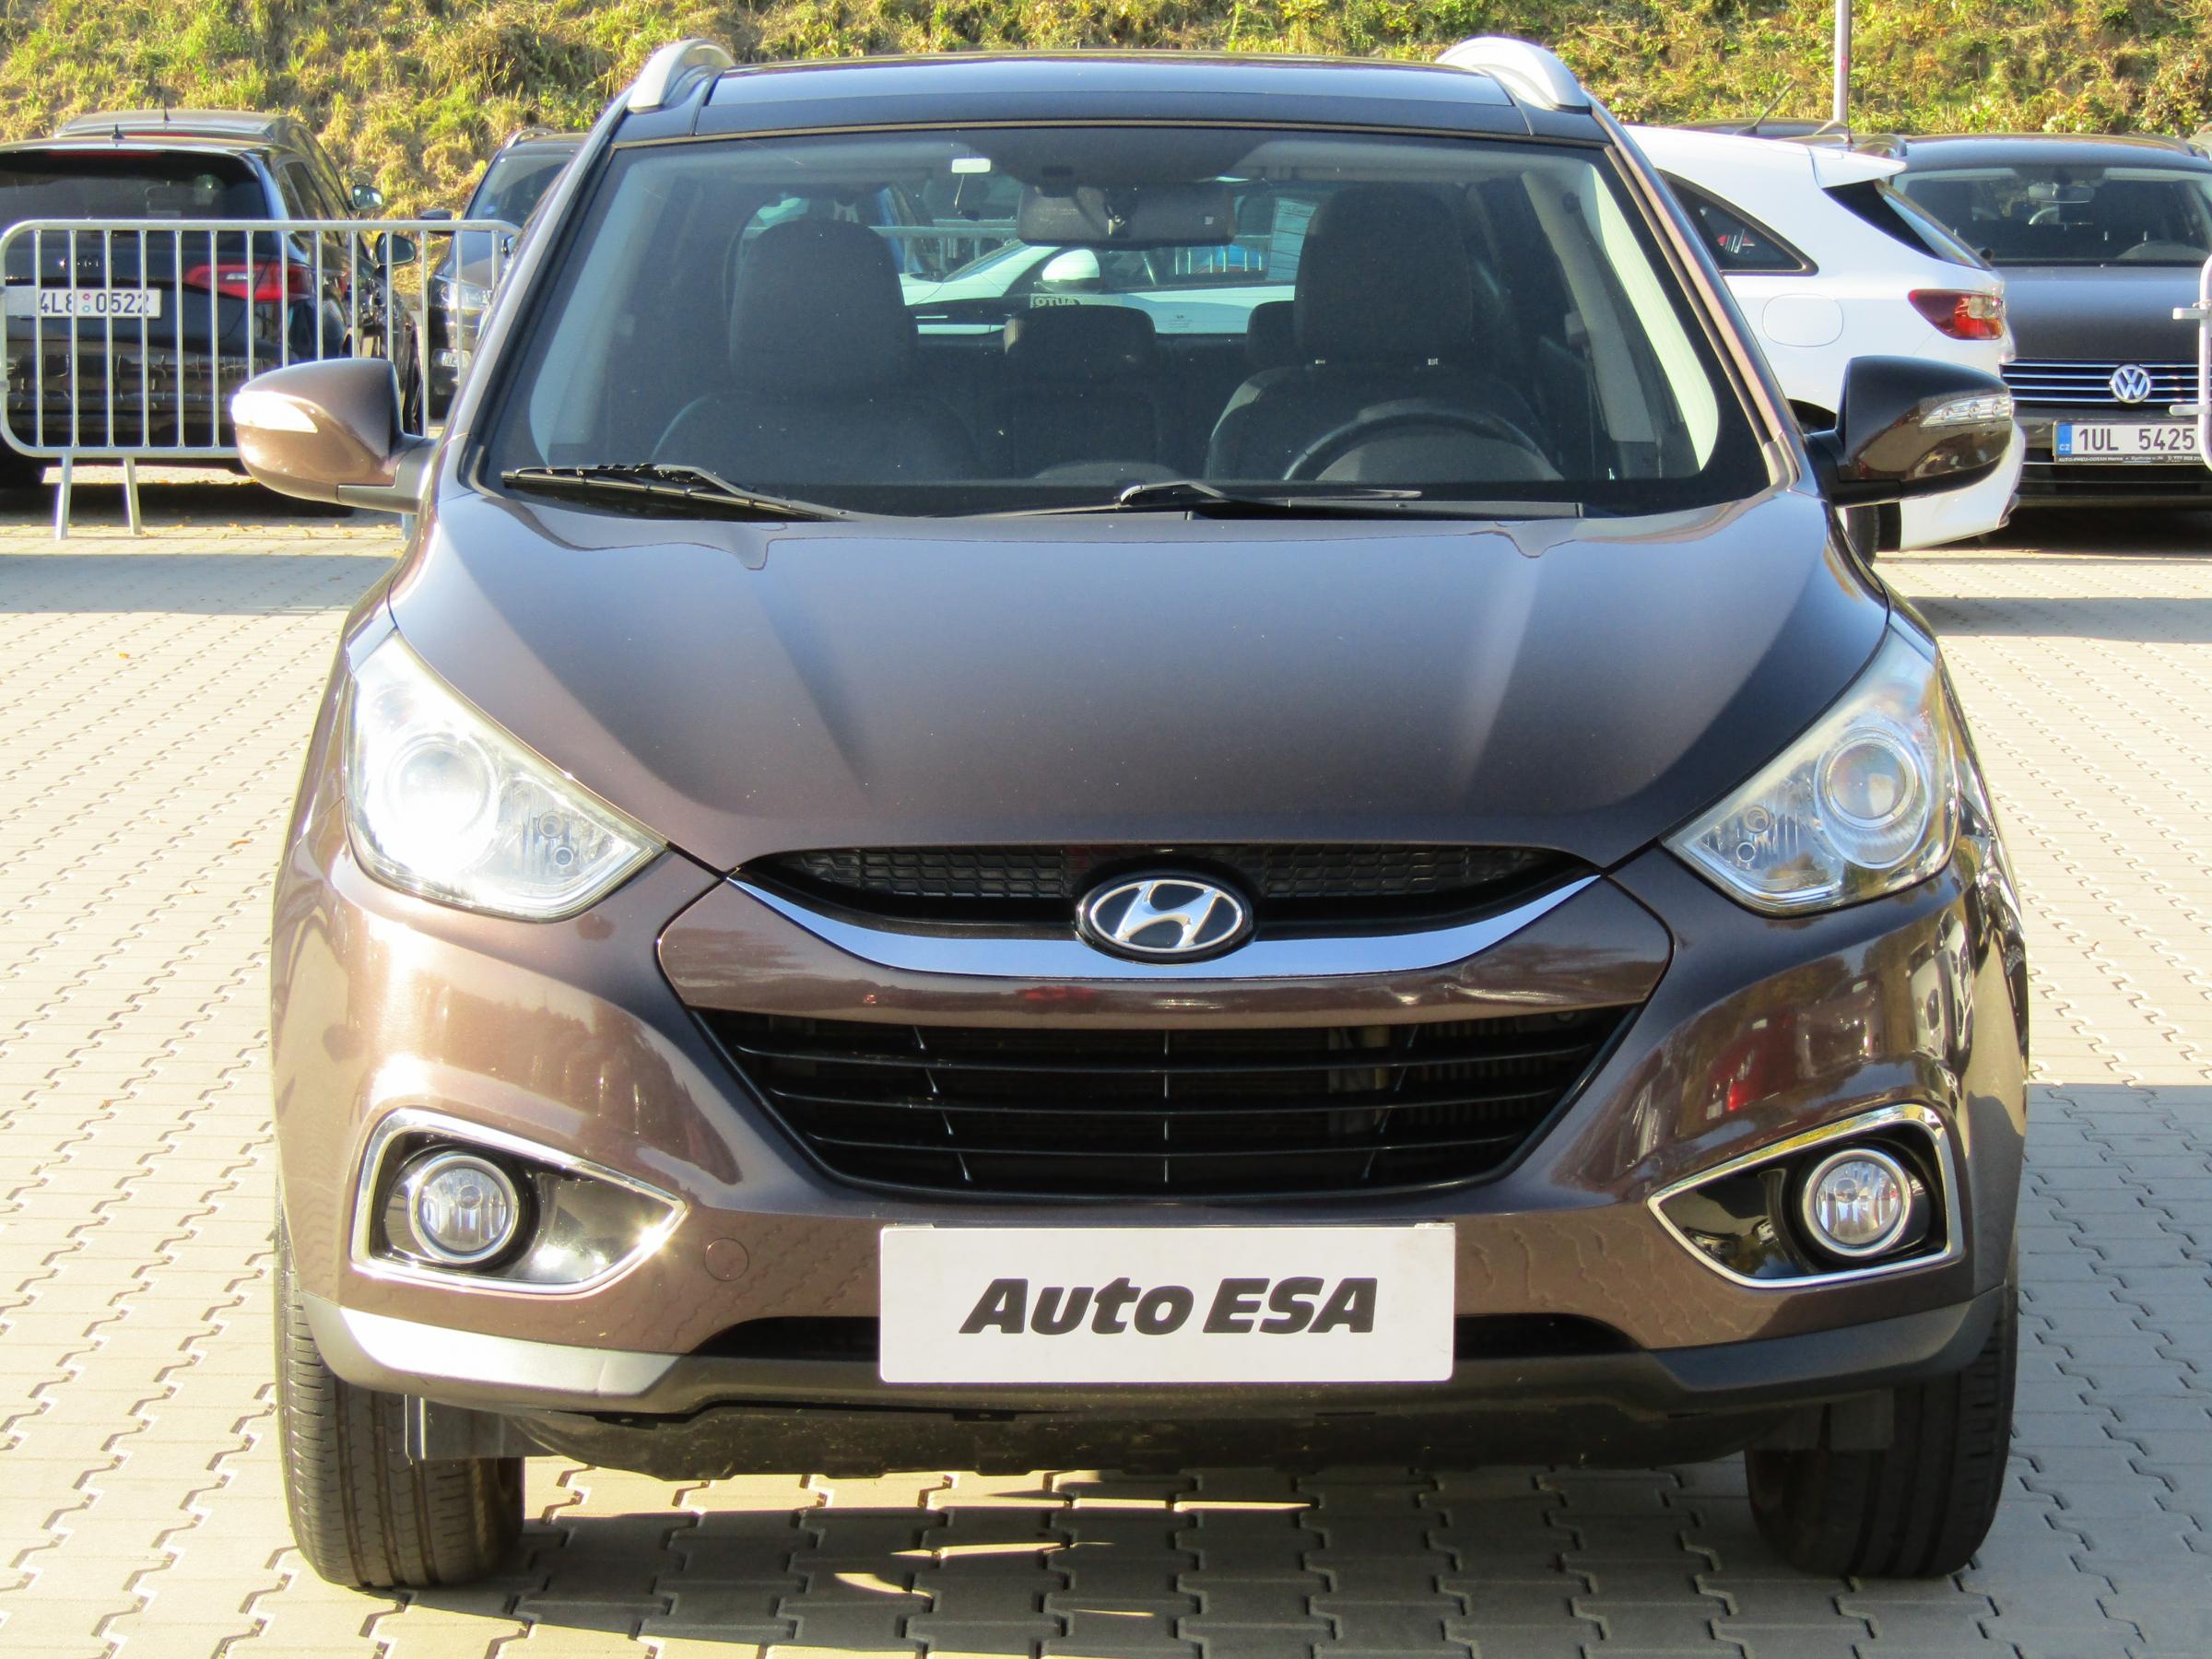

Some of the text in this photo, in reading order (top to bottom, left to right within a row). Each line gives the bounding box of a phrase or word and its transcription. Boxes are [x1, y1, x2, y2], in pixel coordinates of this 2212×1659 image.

[2058, 428, 2195, 452] CZ 1UL 5425
[959, 1277, 1379, 1335] Auto ESA
